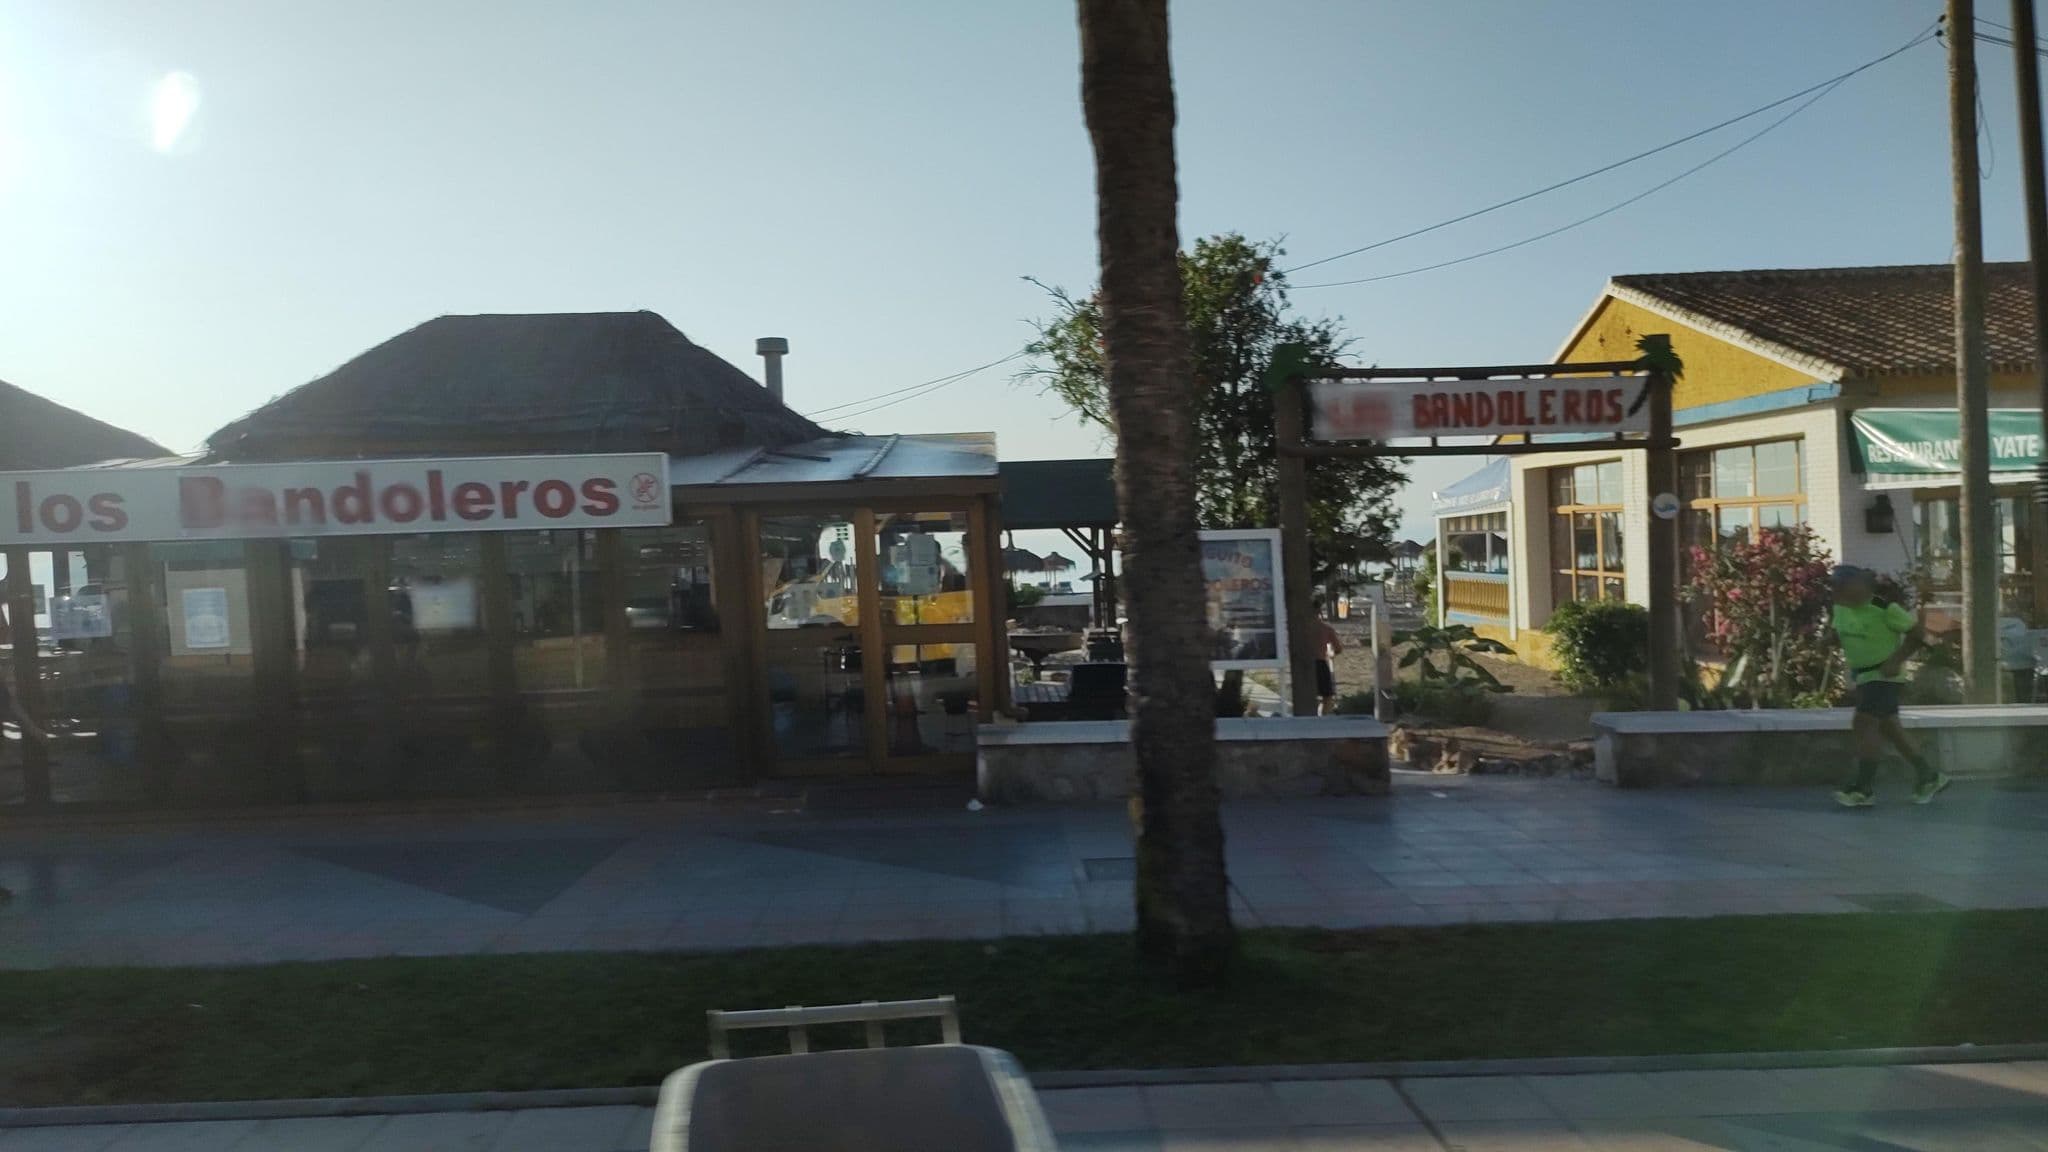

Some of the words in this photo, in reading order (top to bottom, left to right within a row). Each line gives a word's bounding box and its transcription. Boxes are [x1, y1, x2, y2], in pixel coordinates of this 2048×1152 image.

[1412, 389, 1623, 428] BANDOLEROS
[1867, 440, 1962, 463] RESTAURAN
[1993, 434, 2039, 458] YATE
[15, 481, 129, 533] los
